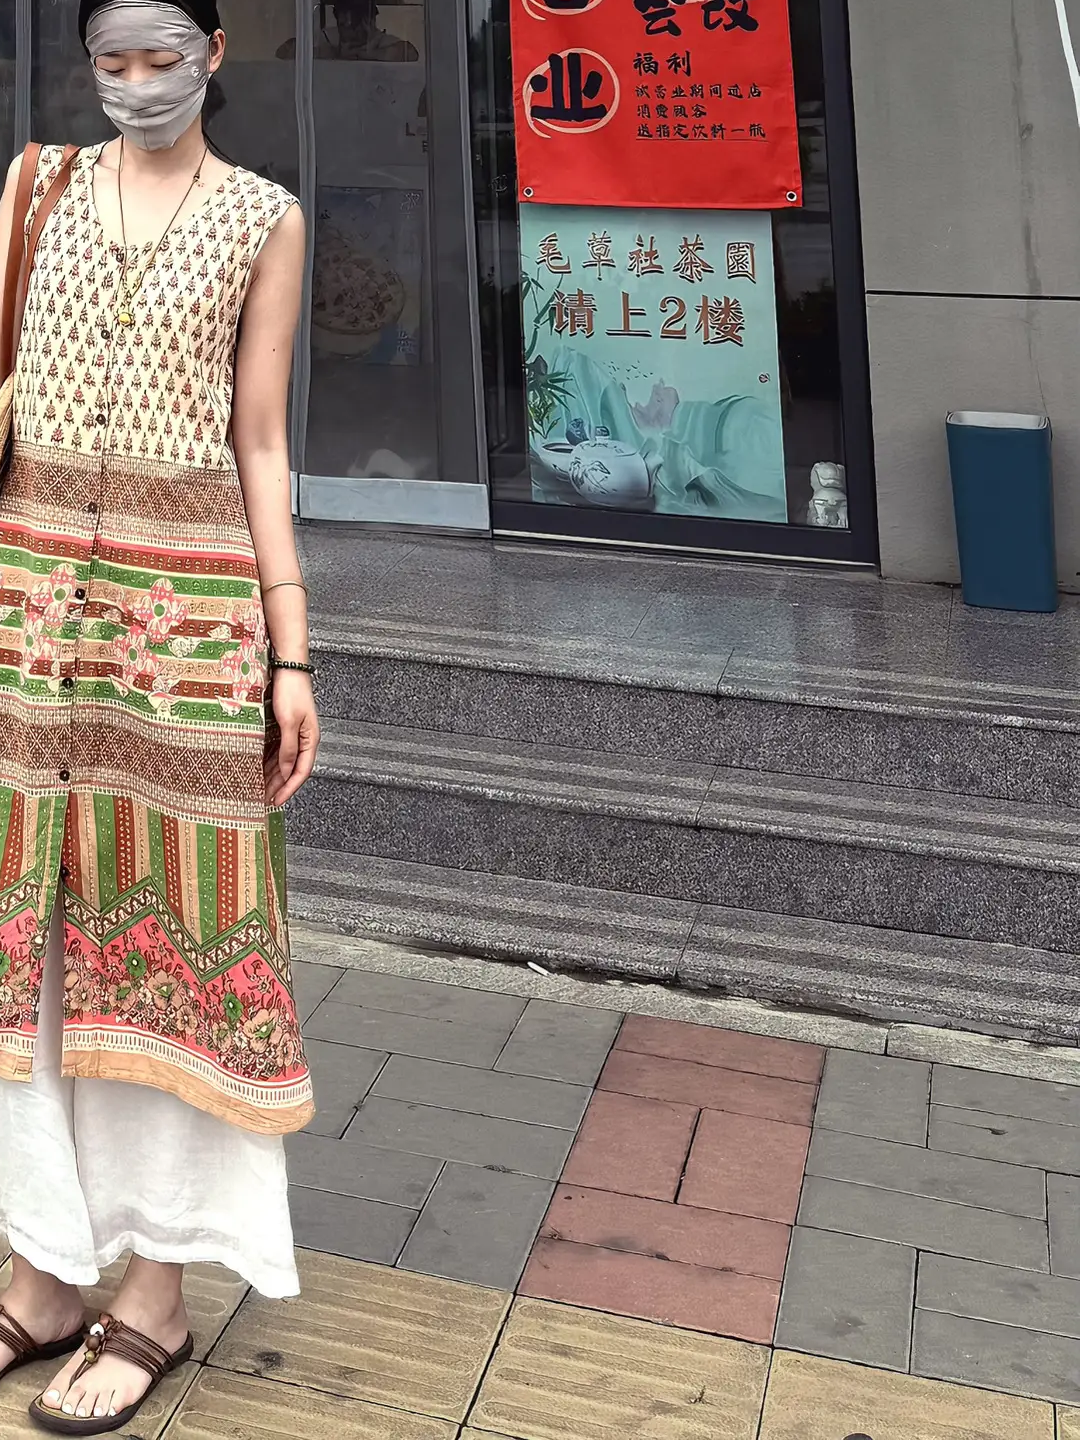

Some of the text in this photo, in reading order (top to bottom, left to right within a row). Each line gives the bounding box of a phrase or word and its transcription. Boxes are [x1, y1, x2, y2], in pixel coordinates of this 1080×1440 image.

[632, 50, 692, 77] 福利
[549, 288, 748, 347] 请上2楼
